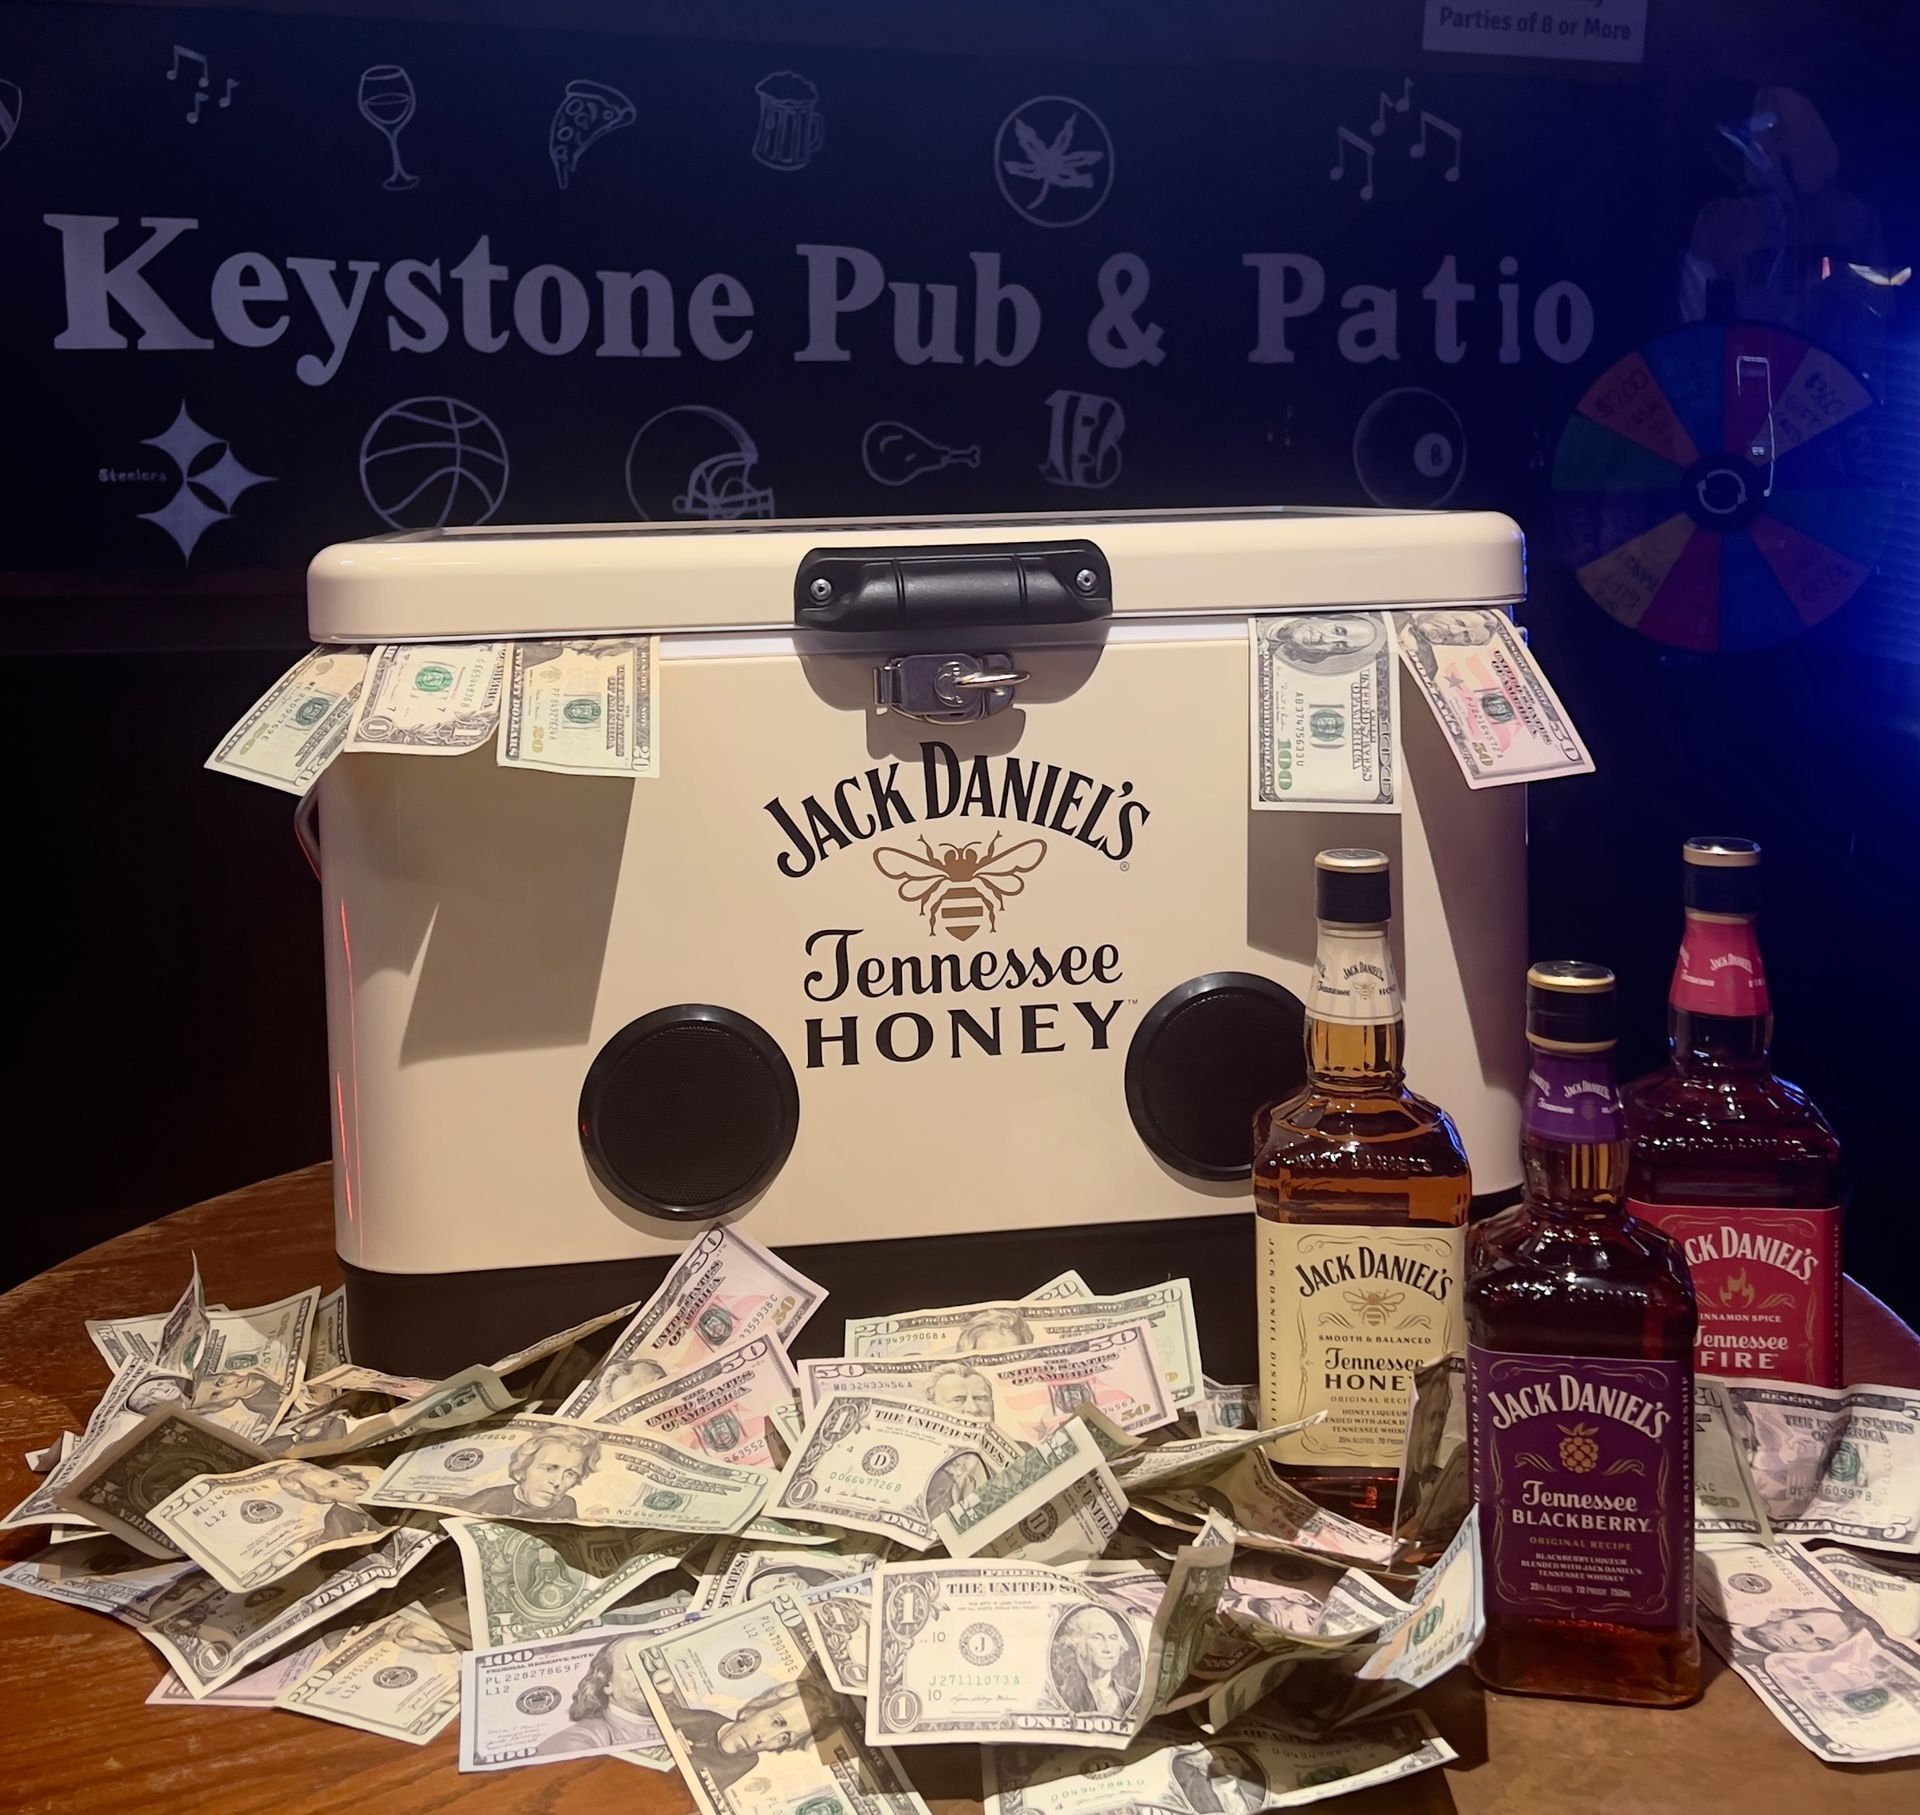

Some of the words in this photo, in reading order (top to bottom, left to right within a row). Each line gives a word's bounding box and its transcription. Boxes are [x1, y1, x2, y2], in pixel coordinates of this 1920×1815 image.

[1440, 6, 1511, 31] Parties
[1517, 12, 1538, 33] of
[1542, 16, 1553, 34] 8
[1558, 20, 1578, 36] or
[1584, 18, 1631, 40] More
[43, 213, 755, 386] Keystone
[793, 244, 1042, 367] Pub
[1086, 252, 1166, 368] &
[1241, 252, 1594, 365] Patio
[1431, 445, 1442, 467] 8
[98, 467, 167, 482] Steelers
[513, 647, 524, 697] TWENTY
[1263, 677, 1271, 733] HUNDRED
[1360, 670, 1371, 724] UNITED
[508, 699, 523, 756] DOLLARS
[532, 725, 544, 753] 20
[1295, 707, 1305, 759] 37475633
[1351, 698, 1361, 769] AMERICA
[1546, 716, 1582, 764] 50
[632, 745, 650, 771] 20
[1278, 738, 1293, 790] 100
[1362, 727, 1372, 782] STATES
[1379, 720, 1391, 796] 100
[1470, 737, 1495, 769] 50
[763, 762, 917, 878] JACK
[919, 741, 1151, 862] DANIEL'S
[804, 928, 1123, 1002] Tennessee
[1343, 963, 1360, 980] JACK
[1360, 961, 1384, 981] DANIEL'S
[805, 999, 1124, 1068] HONEY
[1563, 1082, 1582, 1098] JACK
[689, 1228, 724, 1275] 50
[1268, 1237, 1277, 1278] JACK
[1685, 1233, 1720, 1267] CK
[1720, 1226, 1818, 1282] DANIEL'S
[1295, 1253, 1356, 1297] JACK
[1358, 1246, 1453, 1302] DANIEL'S
[1147, 1287, 1183, 1306] 20
[771, 1295, 796, 1326] 50
[1027, 1307, 1081, 1316] RESERVE
[1097, 1303, 1124, 1312] NOTE
[1268, 1285, 1277, 1343] DANIEL
[1699, 1312, 1749, 1322] INNAMON
[1751, 1314, 1782, 1323] SPICE
[854, 1321, 900, 1336] 20
[910, 1315, 962, 1324] FEDERAL
[1089, 1329, 1137, 1352] 50
[1319, 1335, 1362, 1343] SMOOTH
[1693, 1325, 1789, 1350] Tennessee
[720, 1341, 768, 1373] 50
[976, 1352, 1029, 1364] RESERVE
[1043, 1346, 1072, 1354] NOTE
[997, 1364, 1056, 1380] UNITED
[1057, 1352, 1120, 1371] STATES
[1325, 1347, 1424, 1371] Tennessee
[1700, 1351, 1776, 1370] FIRE
[815, 1364, 865, 1379] 50
[873, 1363, 927, 1371] FEDERAL
[1035, 1364, 1113, 1382] AMERICA
[1325, 1374, 1412, 1391] HONE
[1470, 1361, 1479, 1404] JACK
[618, 1391, 665, 1416] RESERVE
[678, 1372, 706, 1389] NOTE
[646, 1400, 697, 1427] UNITED
[697, 1371, 756, 1404] STATES
[680, 1387, 751, 1424] AMERICA
[1331, 1395, 1379, 1403] ORIGINAL
[1384, 1396, 1409, 1404] RECI
[1121, 1404, 1150, 1422] 50
[1488, 1382, 1558, 1430] JACK
[1559, 1374, 1672, 1439] DANIEL'S
[832, 1411, 849, 1434] 1
[1861, 1416, 1915, 1434] STATES
[607, 1434, 663, 1450] RESERVE
[847, 1445, 854, 1453] 4
[874, 1409, 903, 1422] THE
[906, 1411, 961, 1438] UNITED
[962, 1430, 1006, 1468] STATES
[1471, 1411, 1481, 1477] DANIEL
[873, 1454, 887, 1467] D
[729, 1470, 768, 1486] 20
[159, 1482, 212, 1519] 20
[796, 1483, 809, 1499] 1
[824, 1485, 831, 1495] 4
[1521, 1479, 1638, 1513] Tennessee
[203, 1510, 228, 1528] L12
[882, 1513, 927, 1534] ONE
[1512, 1509, 1650, 1533] BLACKBERRY
[1883, 1515, 1911, 1539] 5
[1529, 1536, 1585, 1548] ORIGINAL
[1590, 1541, 1632, 1551] RECIPE
[239, 1542, 308, 1588] 20
[1521, 1560, 1559, 1569] BLENDED
[1560, 1562, 1581, 1571] WITH
[1581, 1564, 1604, 1572] JACK
[1604, 1565, 1643, 1575] DANIEL'S
[1536, 1553, 1589, 1564] BLACKBERRY
[1590, 1557, 1627, 1565] LIQUEUR
[1538, 1569, 1585, 1579] TENNESSEE
[1585, 1573, 1624, 1582] WHISKEY
[317, 1578, 360, 1608] ONE
[947, 1583, 983, 1594] THE
[989, 1582, 1054, 1594] UNITED
[775, 1593, 801, 1627] 20
[900, 1592, 915, 1624] 1
[743, 1624, 759, 1639] L12
[932, 1632, 946, 1643] 10
[206, 1648, 223, 1667] 1
[481, 1650, 534, 1668] 100
[486, 1663, 526, 1673] FEDERAL
[528, 1657, 569, 1667] RESERVE
[570, 1652, 595, 1661] NOTE
[485, 1676, 501, 1685] PL
[505, 1664, 572, 1683] 22827869
[574, 1662, 582, 1671] F
[929, 1675, 1021, 1687] J27111073A
[288, 1669, 334, 1703] 20
[341, 1684, 360, 1700] L12
[486, 1686, 511, 1696] L12
[928, 1690, 942, 1700] 10
[897, 1697, 908, 1719] 1
[1017, 1716, 1071, 1729] ONE
[486, 1747, 537, 1763] 100
